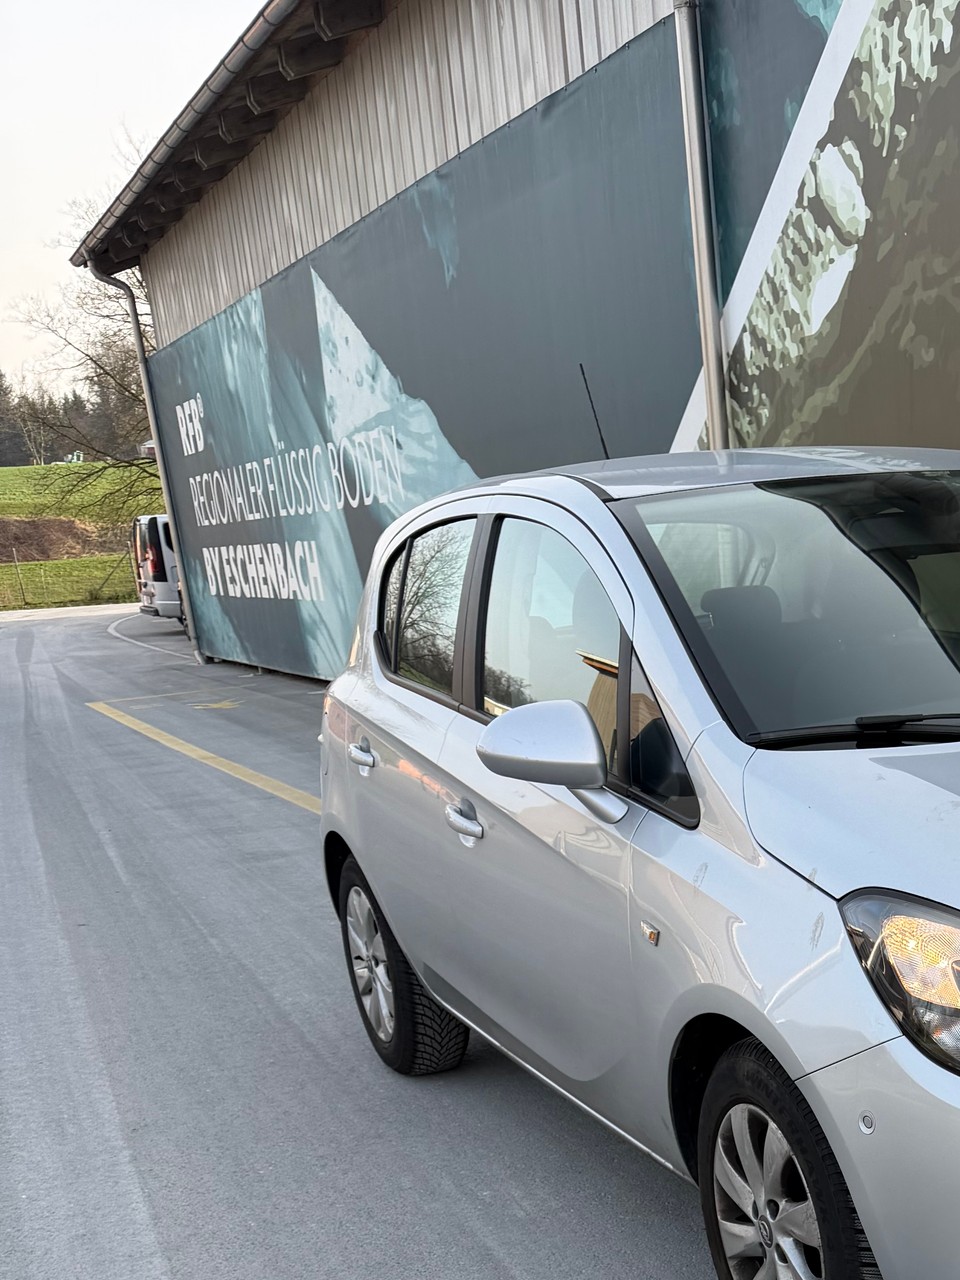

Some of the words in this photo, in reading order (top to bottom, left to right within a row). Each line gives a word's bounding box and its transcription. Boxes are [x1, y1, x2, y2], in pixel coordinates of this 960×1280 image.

[189, 461, 270, 527] REGIONALER
[263, 440, 331, 517] FLÜSSIG
[327, 425, 405, 509] BODEN
[202, 547, 224, 596] BY
[220, 540, 324, 601] ESCHENBACH
